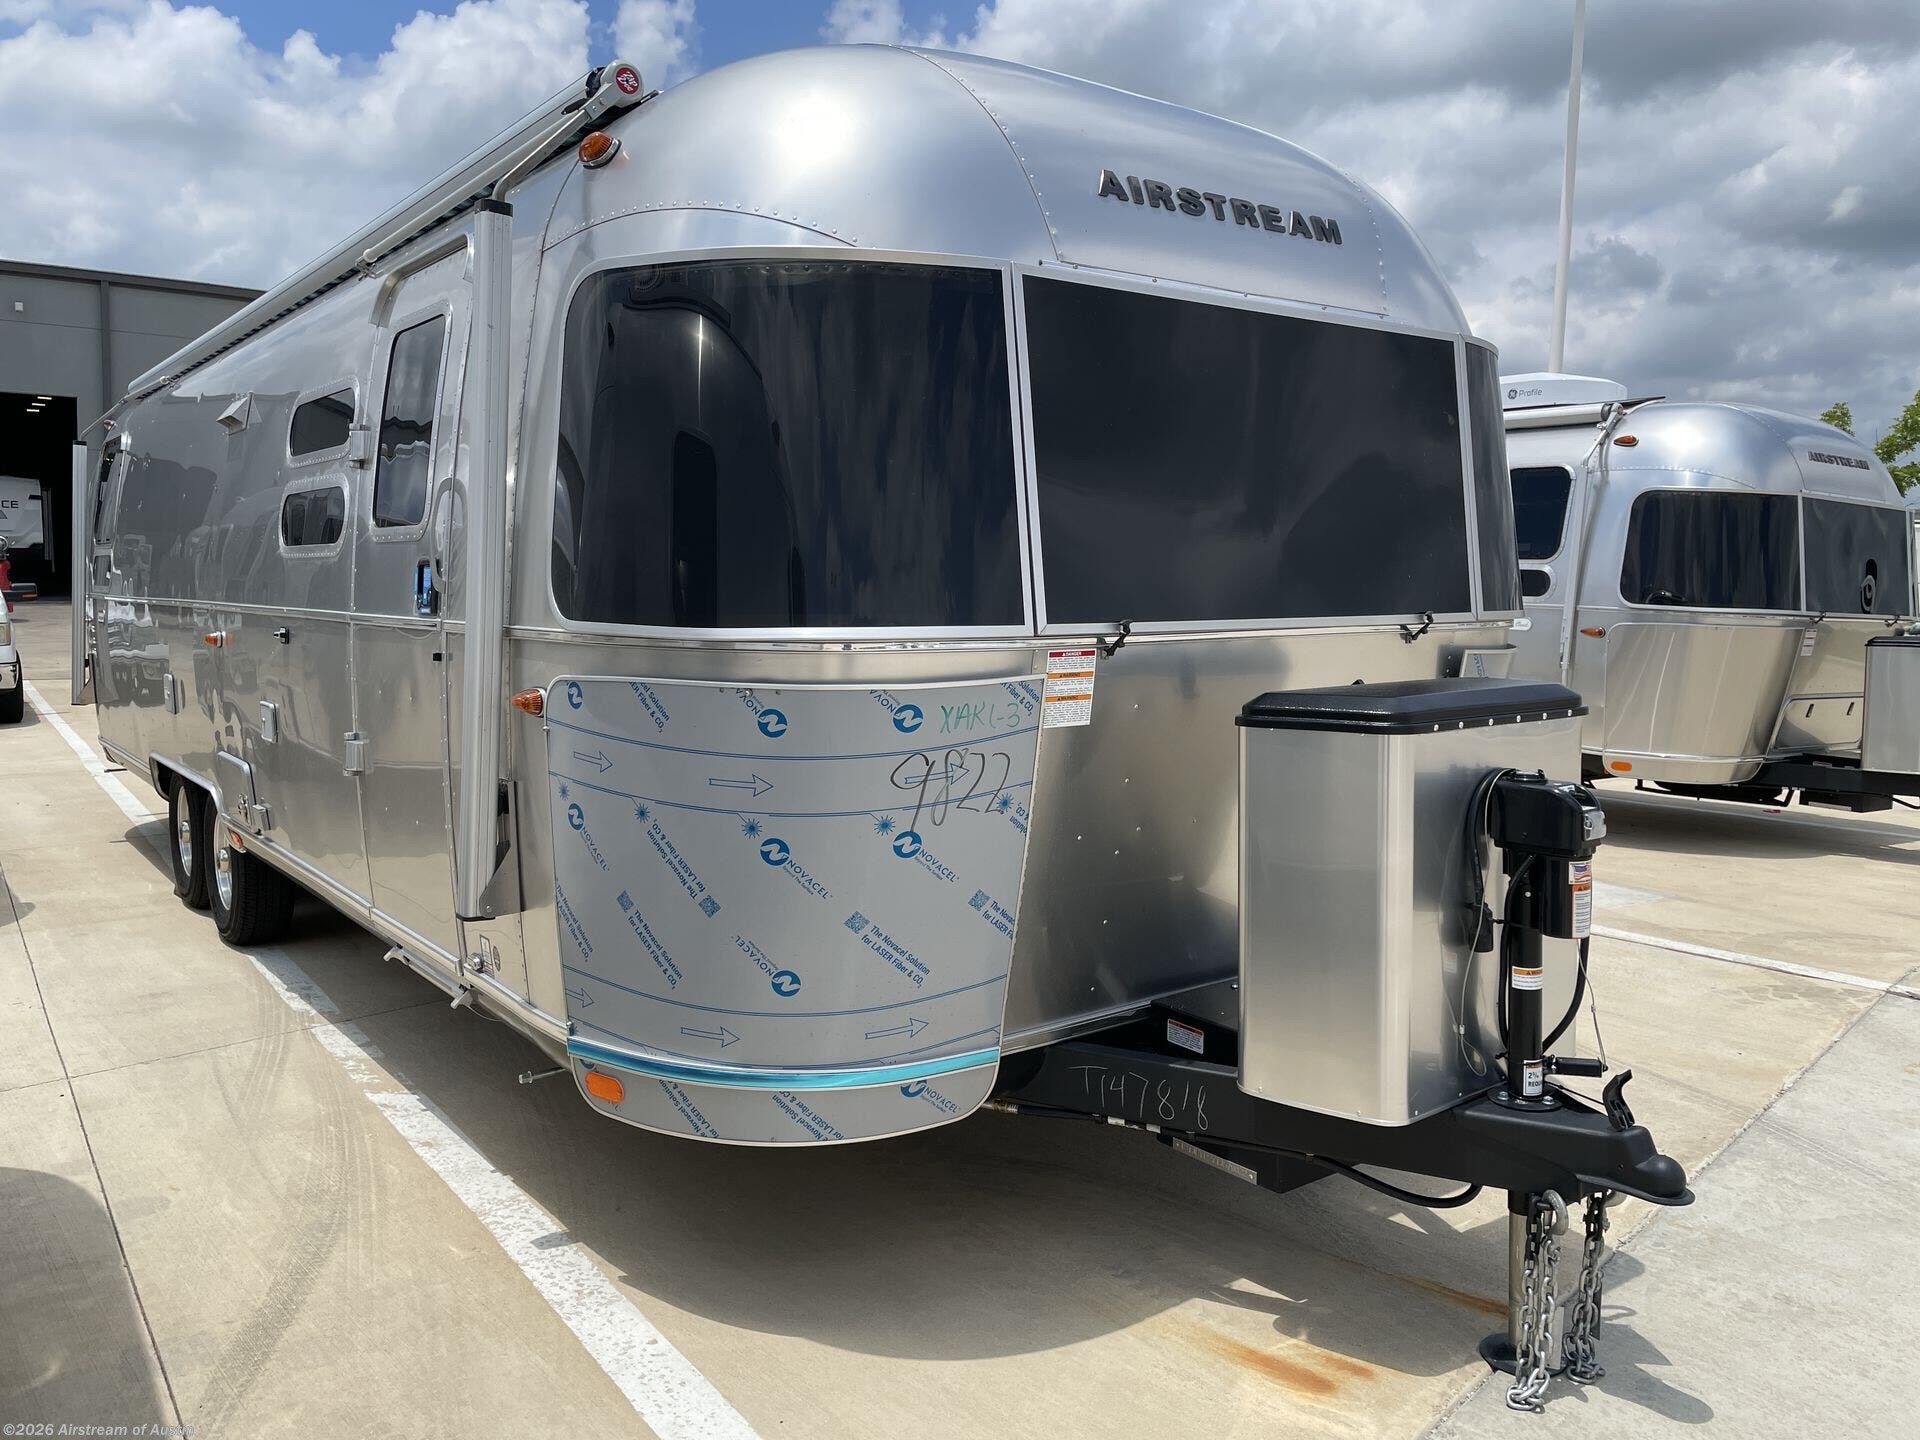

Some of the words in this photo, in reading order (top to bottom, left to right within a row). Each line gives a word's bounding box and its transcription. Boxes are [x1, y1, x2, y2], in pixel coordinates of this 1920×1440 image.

[1097, 169, 1343, 245] AIRSTREAM
[1807, 450, 1871, 471] AIRSTREAM
[638, 692, 651, 711] Fiber
[1006, 683, 1021, 700] Fiber
[649, 691, 670, 722] Solution
[890, 748, 1012, 831] 9822
[582, 826, 607, 871] NOVACEL
[646, 829, 668, 860] Solution
[665, 841, 680, 859] Fiber
[665, 858, 688, 887] Novacel
[678, 858, 697, 882] LASER
[786, 859, 830, 900] NOVACEL
[918, 849, 957, 883] NOVACEL
[686, 885, 698, 900] The
[696, 881, 706, 893] for
[990, 900, 1001, 913] The
[982, 909, 991, 921] for
[990, 916, 1009, 935] LASER
[576, 924, 593, 953] Solution
[628, 915, 637, 927] for
[635, 926, 652, 950] LASER
[650, 949, 664, 968] Fiber
[634, 909, 644, 923] The
[642, 923, 664, 951] Novacel
[661, 950, 683, 980] Solution
[870, 925, 882, 939] The
[881, 934, 909, 957] Novacel
[905, 953, 931, 975] Solution
[735, 935, 775, 977] NOVACEL
[861, 934, 872, 946] for
[870, 941, 894, 962] LASER
[891, 957, 909, 975] Fiber
[906, 970, 914, 978] &
[678, 1089, 693, 1108] Fiber
[772, 1094, 799, 1120] Solution
[796, 1100, 814, 1117] Fiber
[924, 1086, 958, 1113] NOVACEL
[678, 1106, 701, 1133] Novacel
[691, 1106, 711, 1129] LASER
[796, 1117, 823, 1139] Novacel
[811, 1114, 835, 1134] LASER
